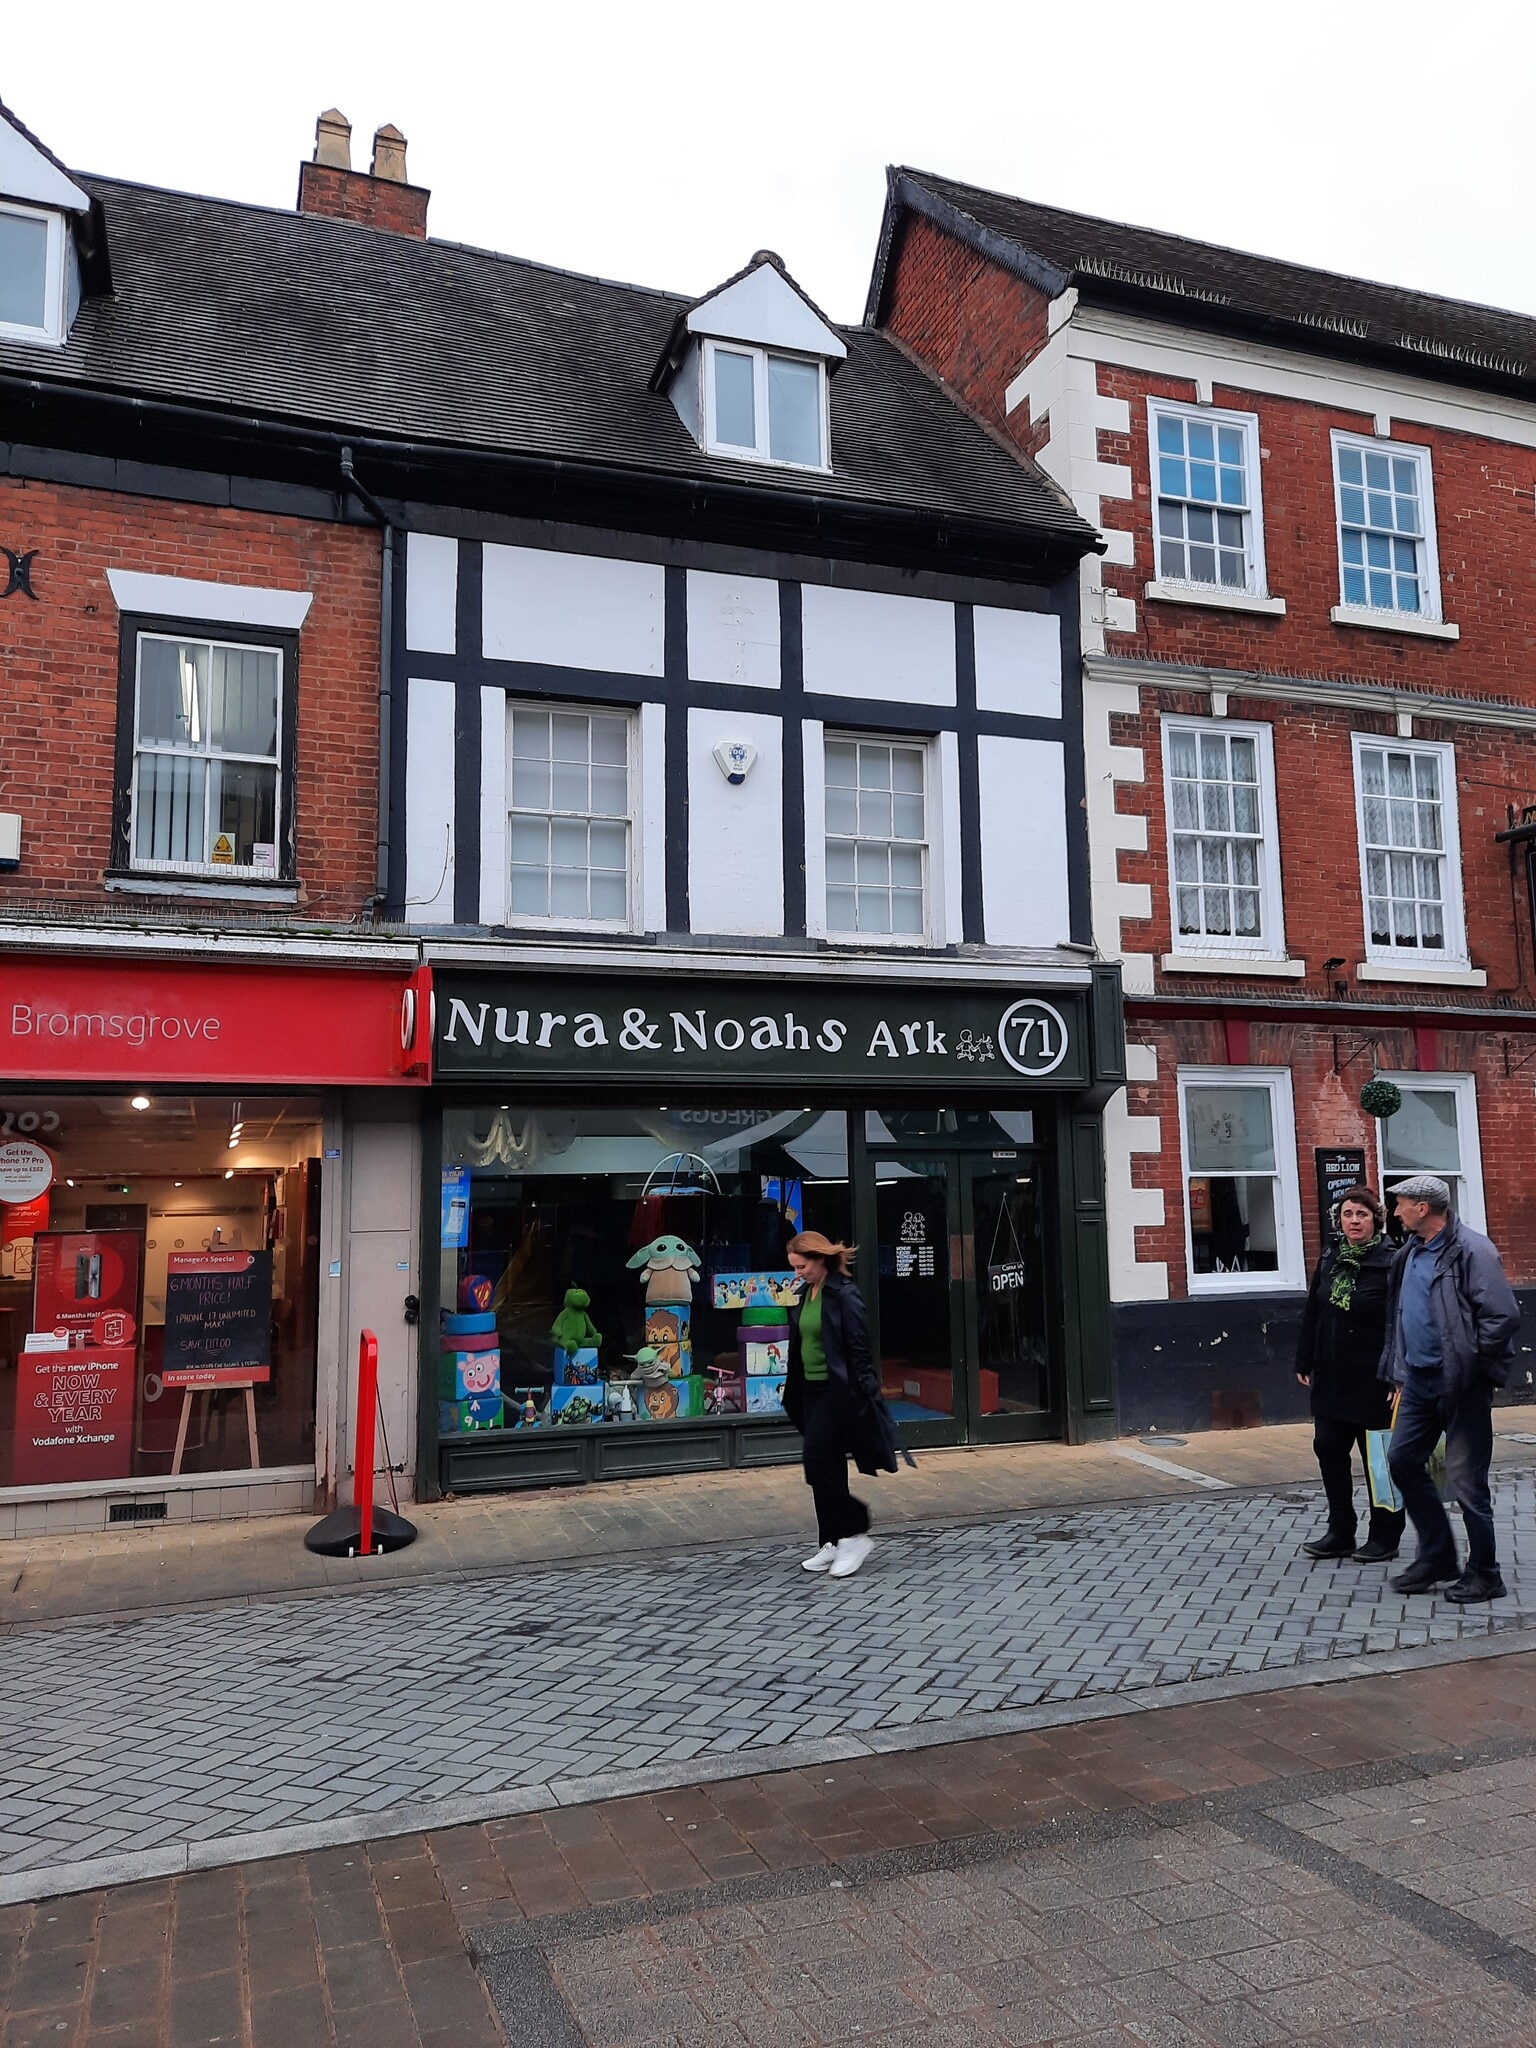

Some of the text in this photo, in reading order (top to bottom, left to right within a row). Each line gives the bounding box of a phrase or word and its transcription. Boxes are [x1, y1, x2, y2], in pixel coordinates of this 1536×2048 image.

[11, 1004, 220, 1046] Bromsgrove
[443, 998, 948, 1057] Nura & Noahs Ark
[1011, 1017, 1055, 1057] 71
[1325, 1163, 1360, 1173] RED LION
[1327, 1177, 1357, 1190] OPENING
[173, 1255, 235, 1264] Manager's Special
[170, 1275, 257, 1292] 6 MONTHS HALF
[992, 1270, 1024, 1291] OPEN
[199, 1291, 231, 1306] PRICE!
[208, 1311, 216, 1321] 17
[218, 1309, 256, 1321] UNLIMITED
[180, 1339, 202, 1351] SAVE
[35, 1362, 119, 1374] Get the new iPhone
[52, 1374, 100, 1391] NOW
[196, 1373, 216, 1381] today
[33, 1388, 117, 1408] & EVERY
[48, 1406, 102, 1423] YEAR
[65, 1425, 84, 1434] with
[32, 1433, 115, 1447] Vodafone Xchange
